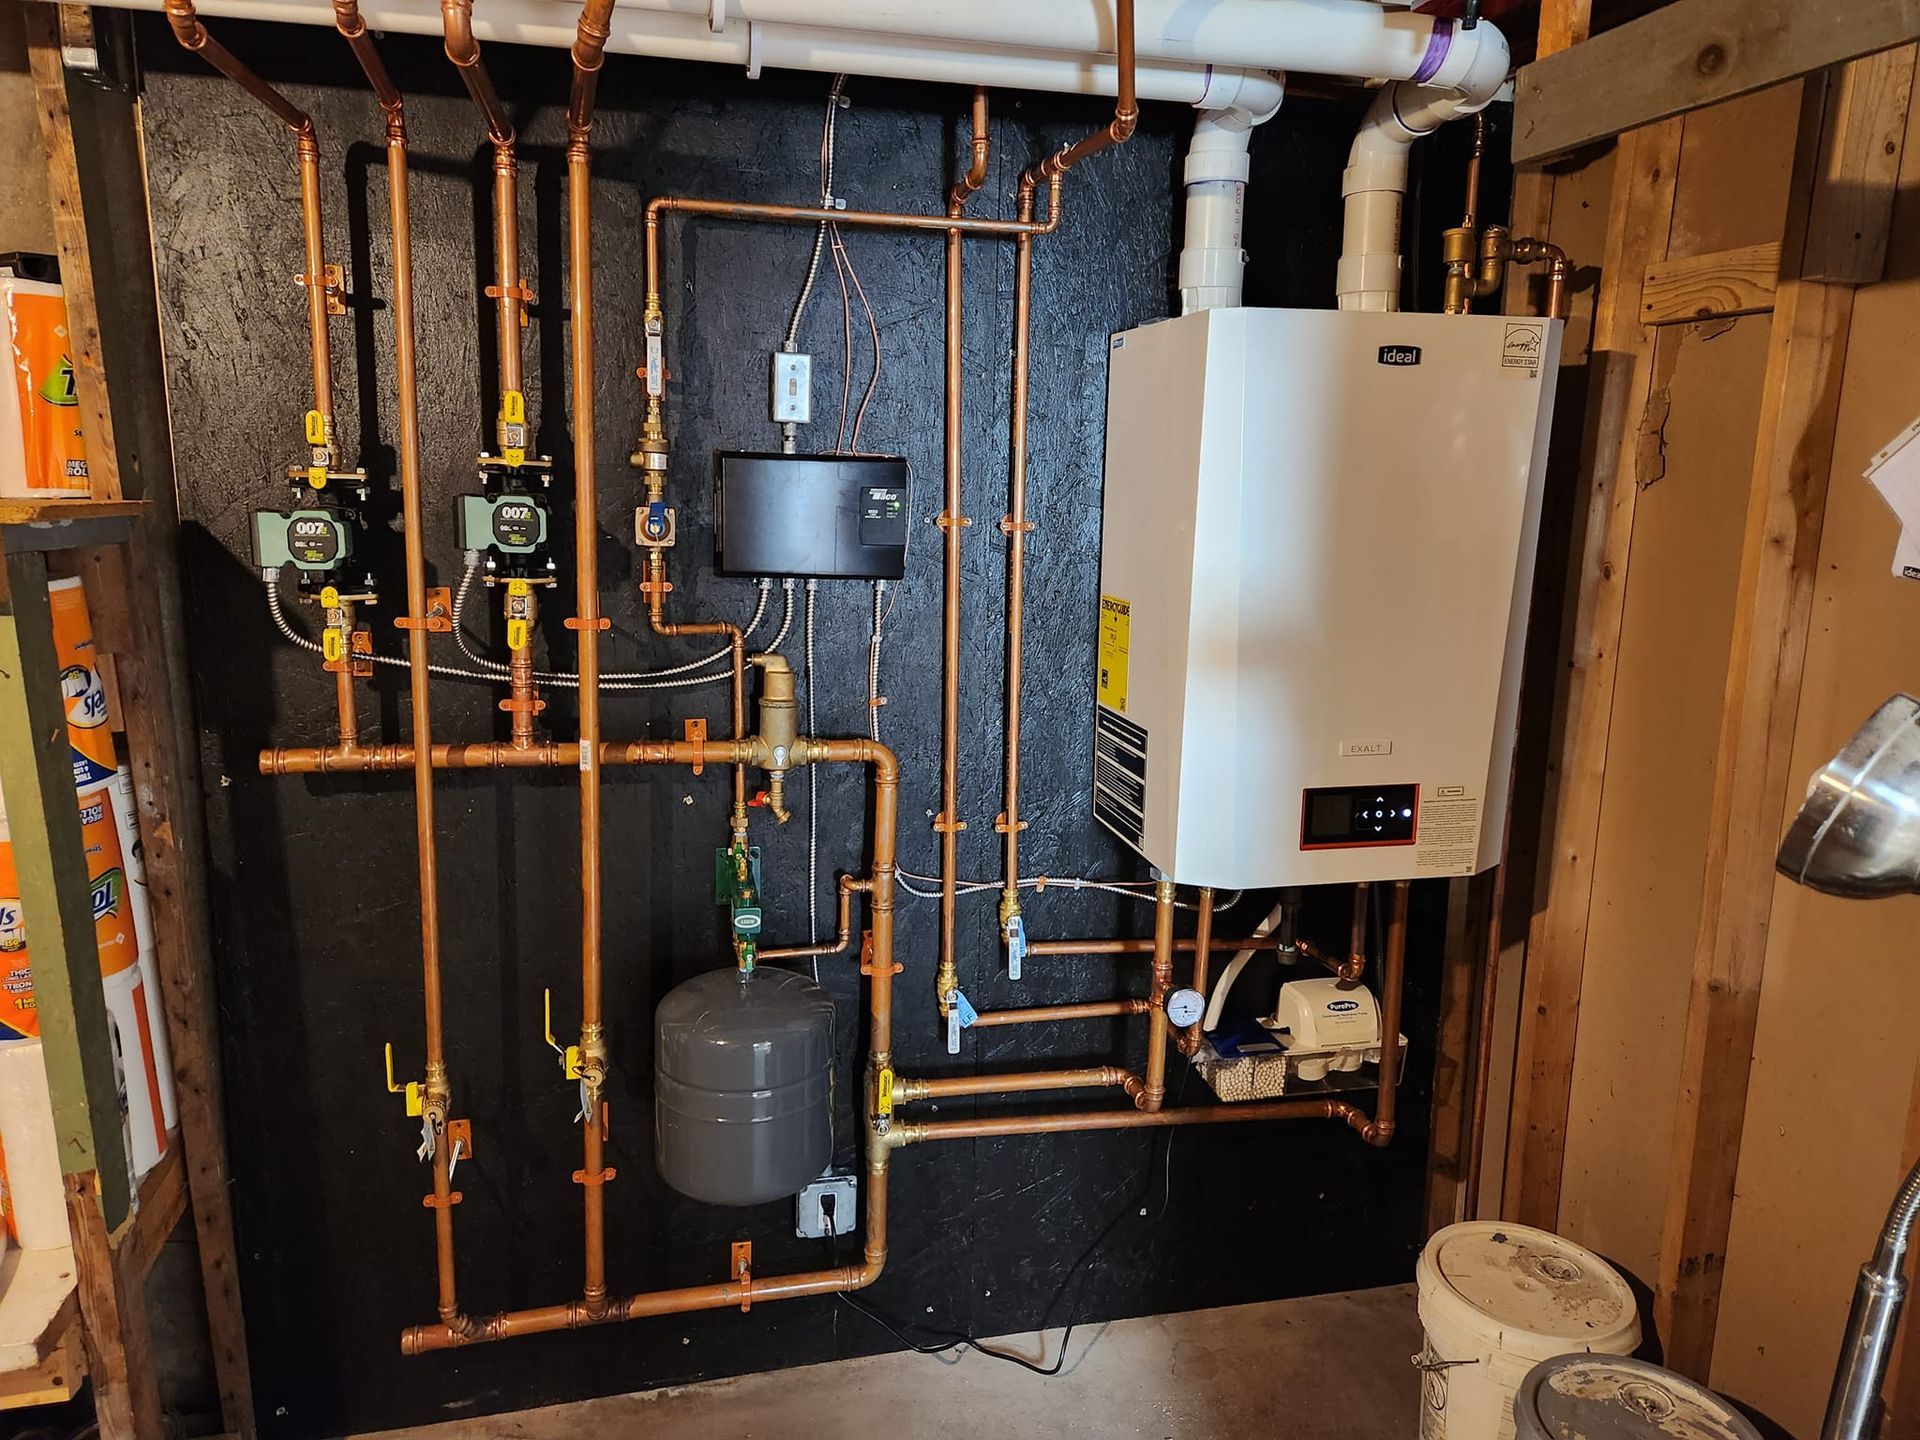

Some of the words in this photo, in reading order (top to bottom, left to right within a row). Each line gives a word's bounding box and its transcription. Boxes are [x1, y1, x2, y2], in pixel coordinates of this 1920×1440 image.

[1383, 348, 1416, 363] ideal
[1524, 358, 1537, 366] STAR
[1351, 744, 1382, 753] EXALT
[5, 939, 19, 947] 150
